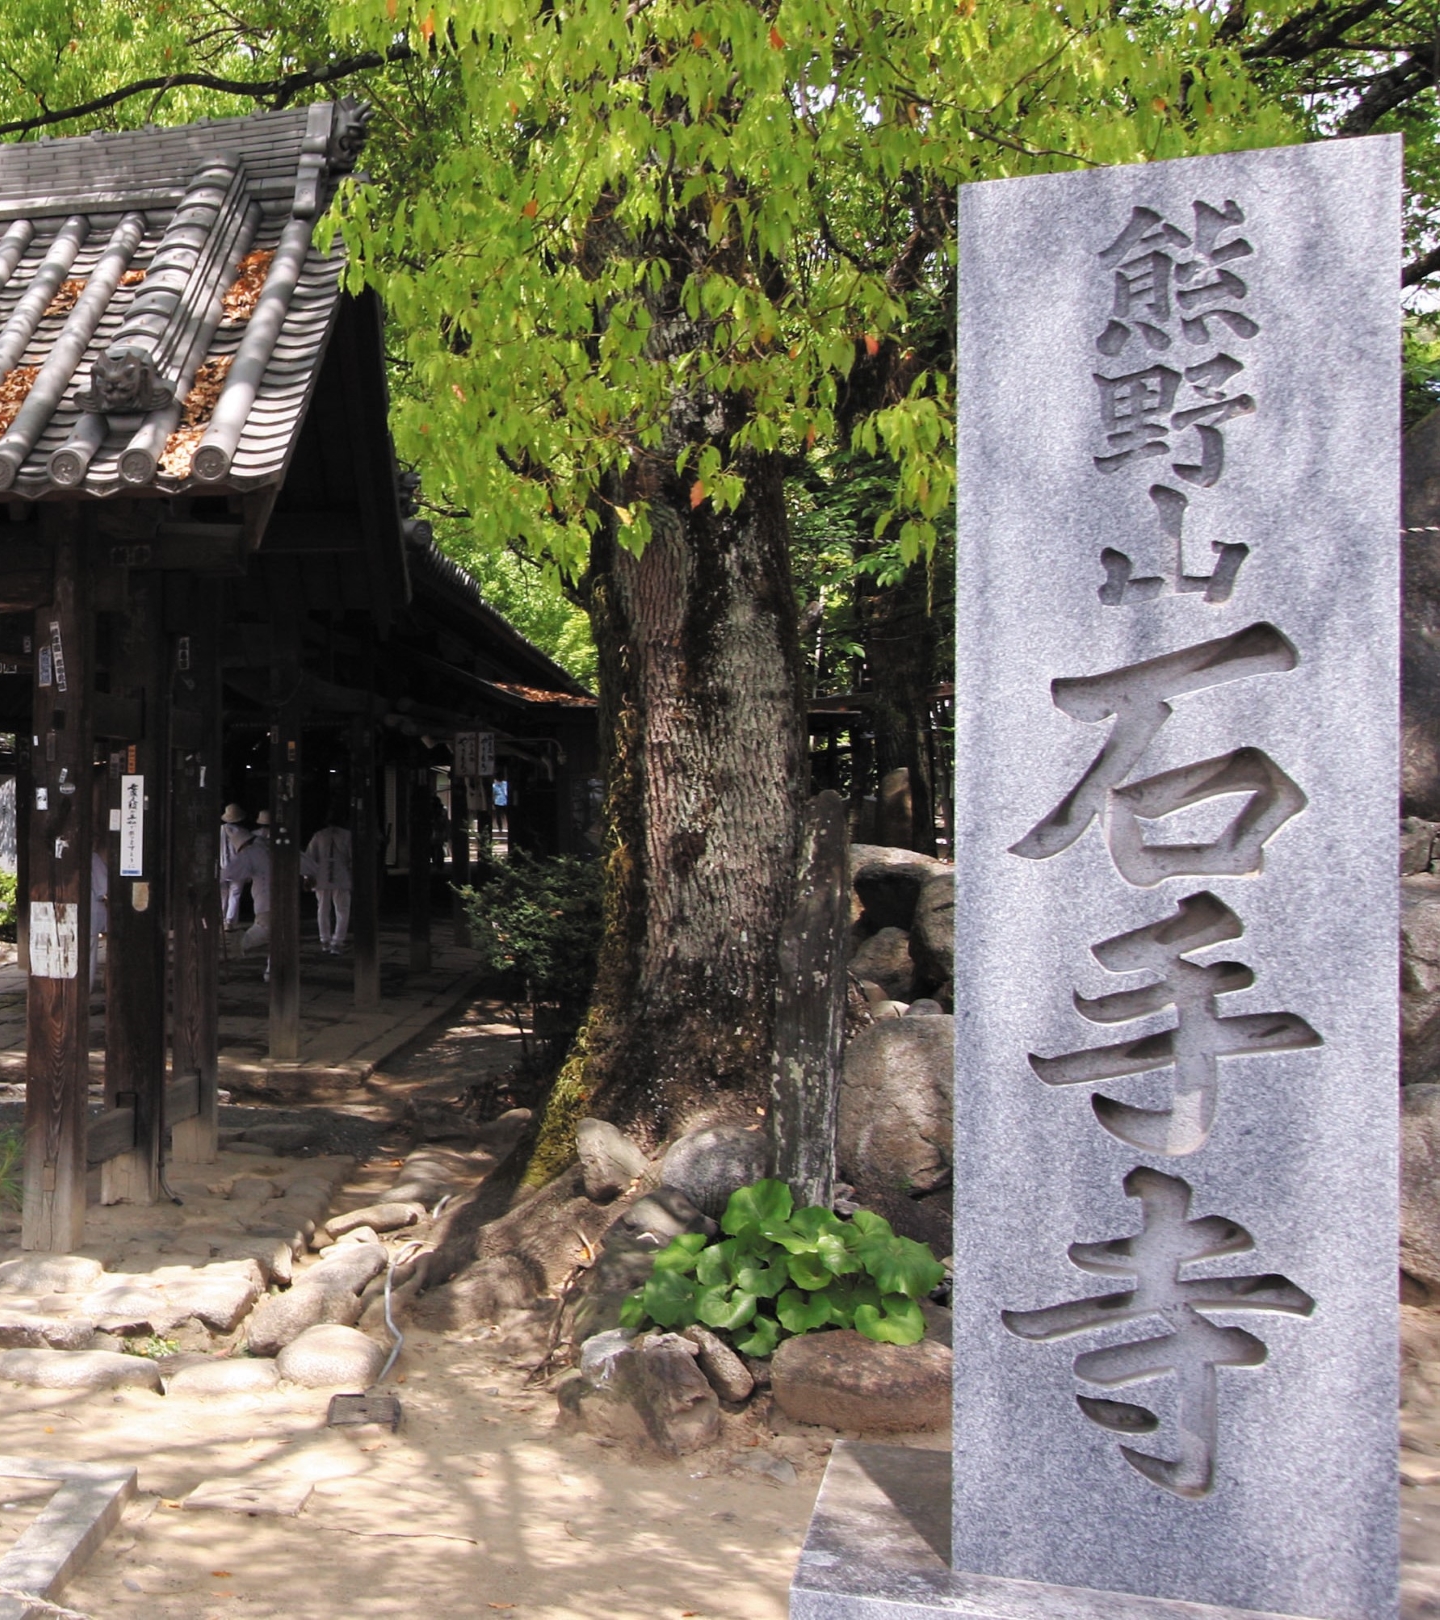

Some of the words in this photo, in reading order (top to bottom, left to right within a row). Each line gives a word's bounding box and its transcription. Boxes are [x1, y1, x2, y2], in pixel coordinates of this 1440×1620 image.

[1000, 199, 1324, 1499] 熊野山石手寺
